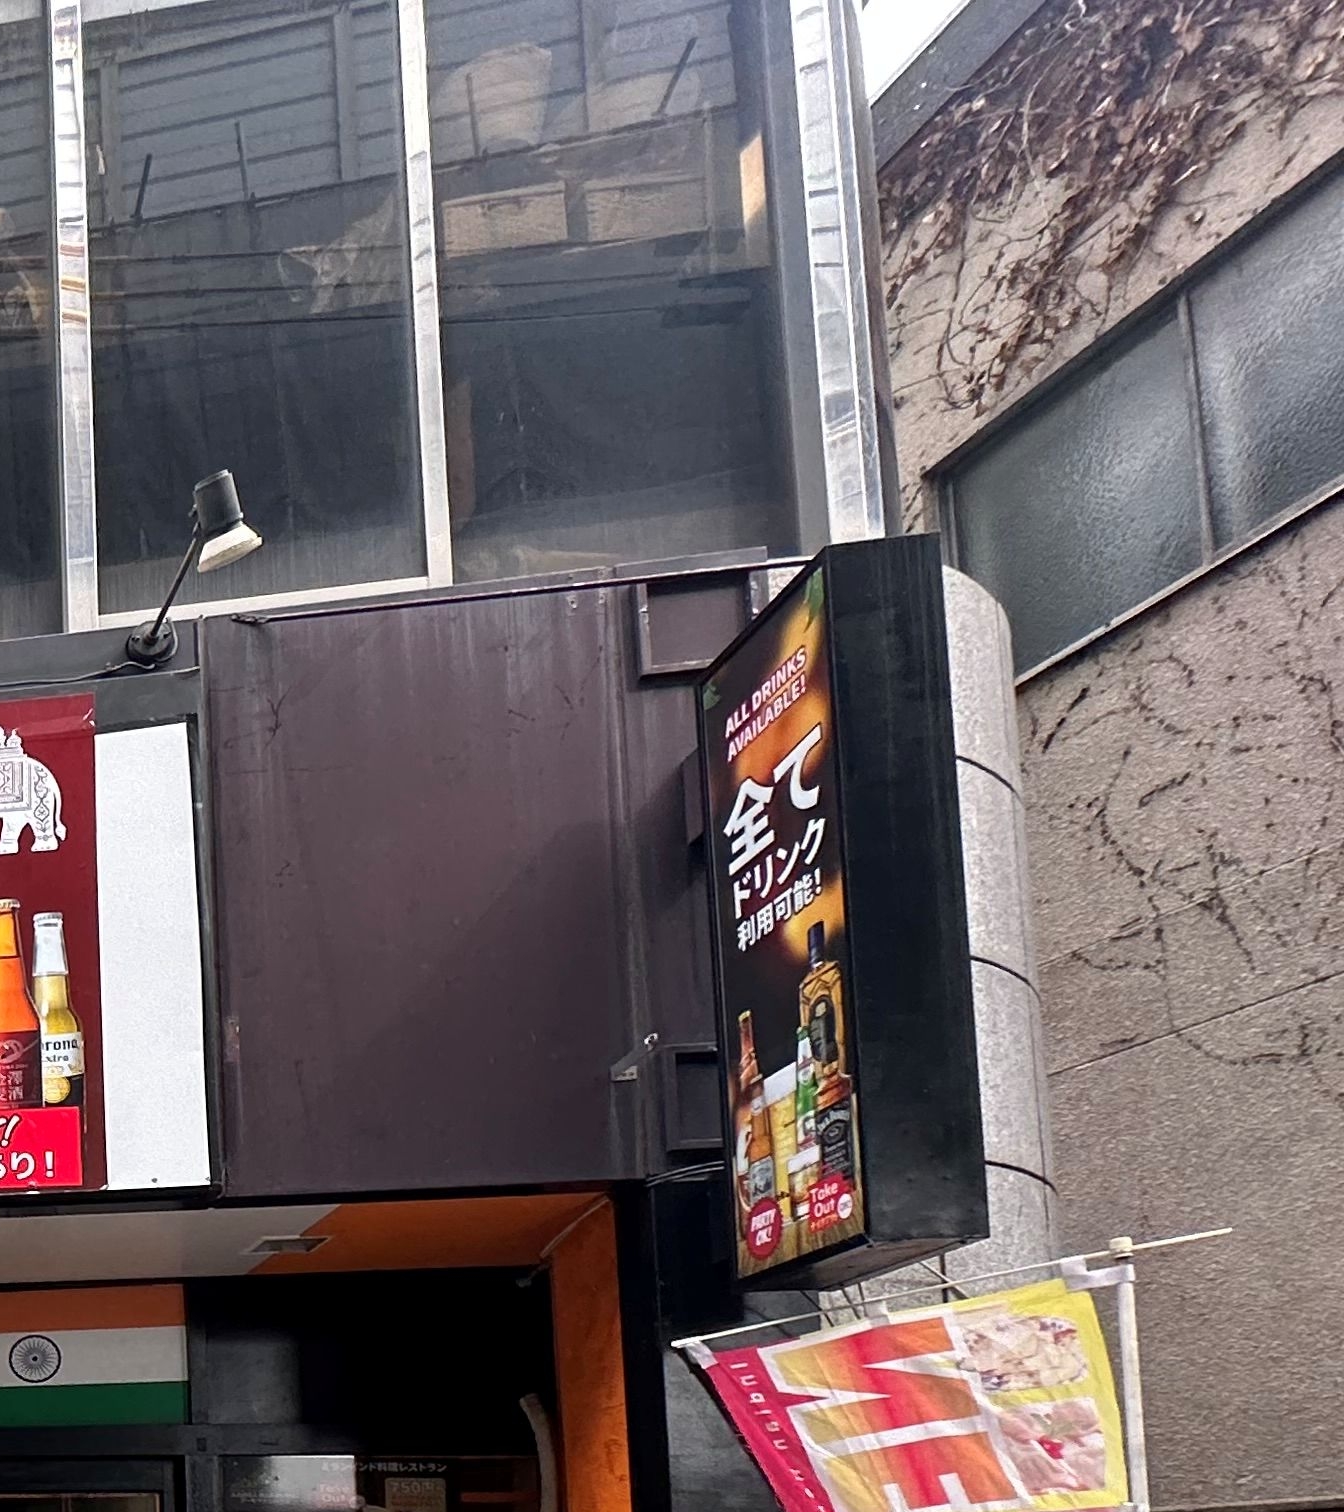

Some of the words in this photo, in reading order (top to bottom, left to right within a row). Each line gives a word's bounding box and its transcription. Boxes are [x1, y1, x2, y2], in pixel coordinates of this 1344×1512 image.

[725, 710, 750, 739] ALL
[751, 645, 806, 713] DRINKS
[727, 674, 806, 762] AVAILABLE!
[723, 722, 822, 876] 全て
[733, 818, 826, 919] ドリンク
